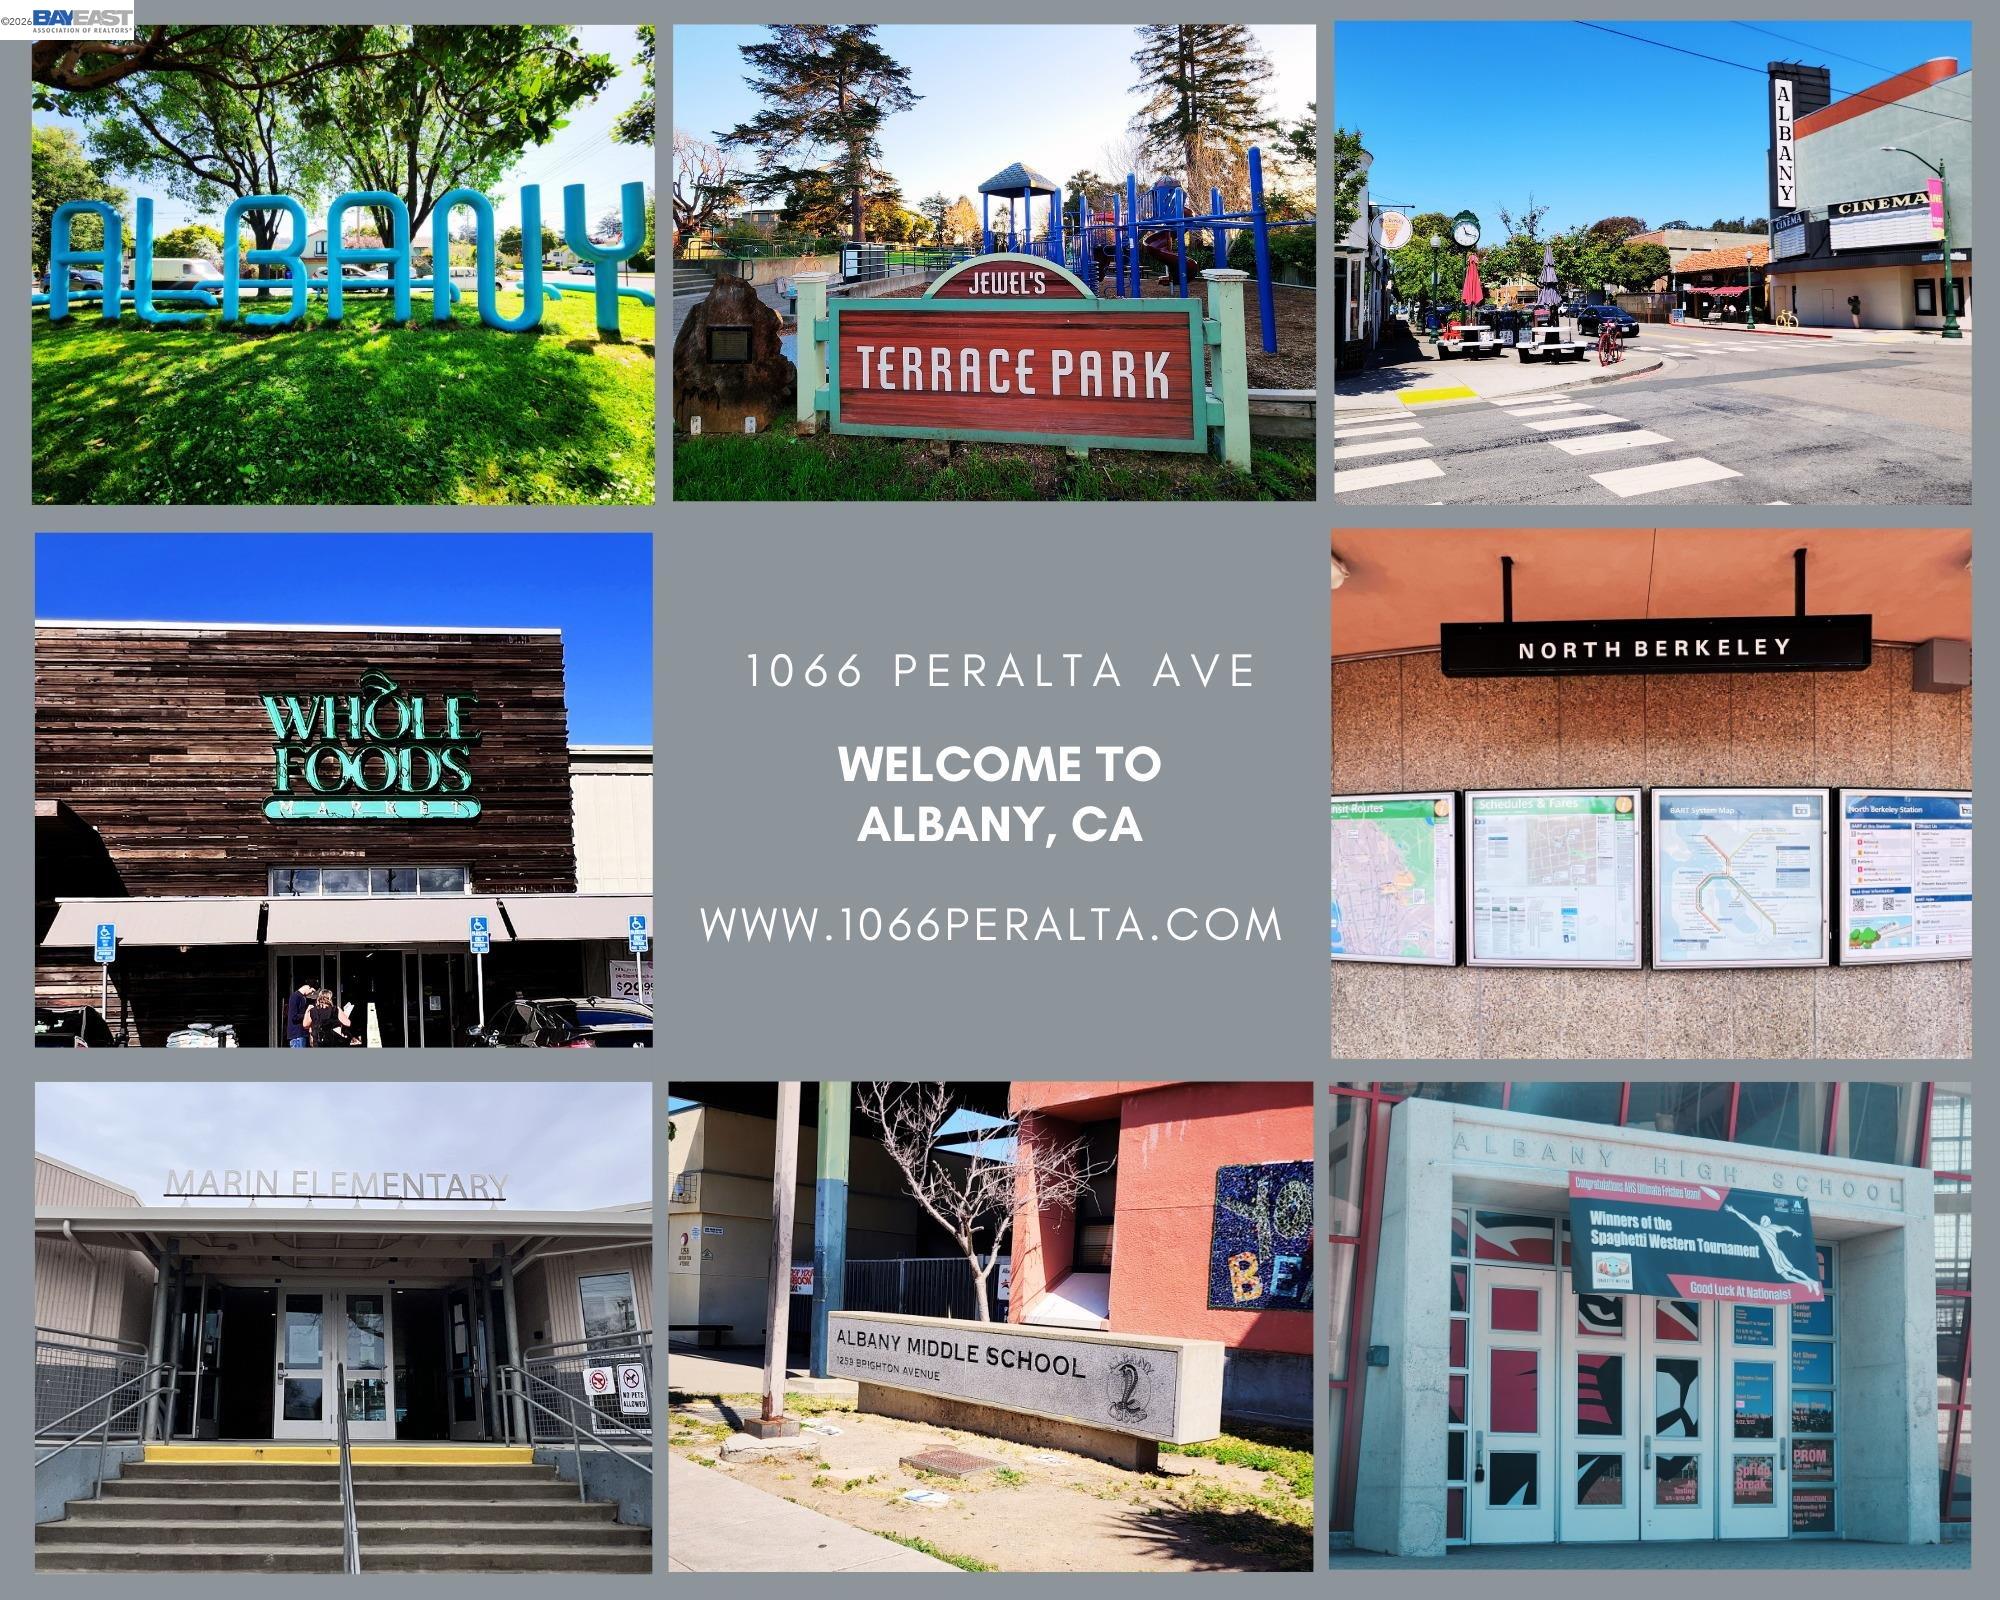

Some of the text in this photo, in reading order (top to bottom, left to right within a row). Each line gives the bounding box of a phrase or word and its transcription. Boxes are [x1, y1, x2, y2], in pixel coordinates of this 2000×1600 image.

[1777, 86, 1794, 200] ALBANY
[1838, 193, 1930, 215] CINEMA
[1776, 213, 1802, 230] CINEMA
[49, 181, 645, 341] ALBANY
[968, 271, 1046, 295] JEWEL'S
[856, 346, 1171, 399] TERRACE PARK
[1519, 638, 1790, 659] NORTH BERKELEY
[259, 690, 482, 743] WHOLE
[272, 742, 473, 795] FOODS
[279, 800, 462, 814] MARKET
[1351, 804, 1384, 813] Routes
[1479, 798, 1533, 809] Schedules
[1537, 799, 1545, 808] &
[1691, 807, 1718, 816] System
[1718, 808, 1735, 816] Map
[1871, 806, 1898, 815] Berkeley
[1453, 1131, 1904, 1204] ALBANY HIGH SCHOOL
[166, 1169, 509, 1199] MARIN ELEMENTARY
[1590, 1210, 1672, 1231] Winners of the
[1591, 1230, 1760, 1259] Spaghetti Western Tournament
[1690, 1281, 1792, 1301] Good Luck At Nationals!
[837, 1329, 1086, 1379] ALBANY MIDDLE SCHOOL
[836, 1356, 940, 1381] 1259 BRIGHTON AVENUE
[1793, 1449, 1827, 1463] PROM
[1736, 1463, 1771, 1477] Spring
[1736, 1479, 1767, 1490] Break
